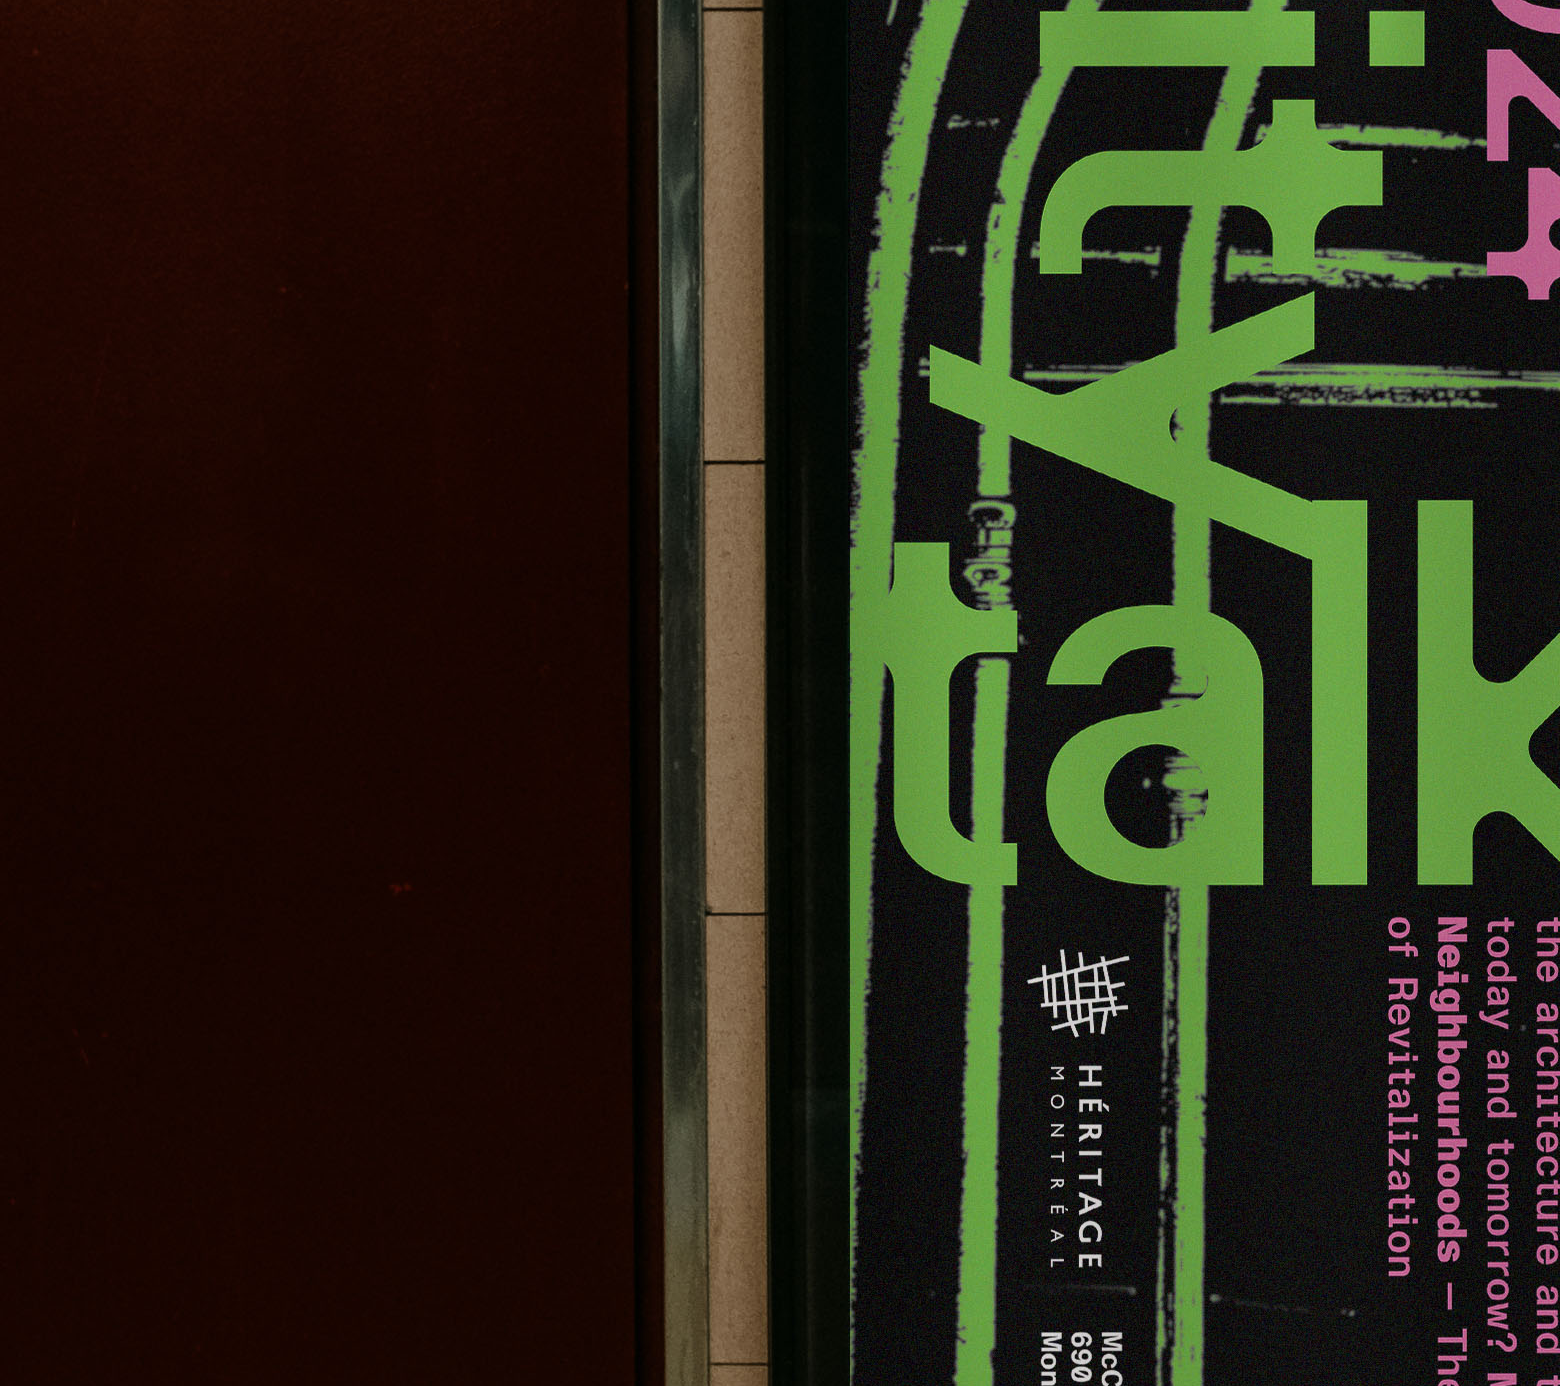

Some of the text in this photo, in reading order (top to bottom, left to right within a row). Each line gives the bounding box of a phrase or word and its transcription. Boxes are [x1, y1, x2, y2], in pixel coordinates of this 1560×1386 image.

[1480, 918, 1519, 1030] today
[1050, 1066, 1067, 1268] MONTRÉAL
[1078, 1065, 1110, 1268] HÉRITAGE
[1387, 918, 1420, 1277] of Revitalization
[1429, 918, 1470, 1263] Neighbourhoods
[1486, 1051, 1519, 1118] and
[1486, 1140, 1519, 1353] tomorrow?
[1069, 1331, 1094, 1383] 690
